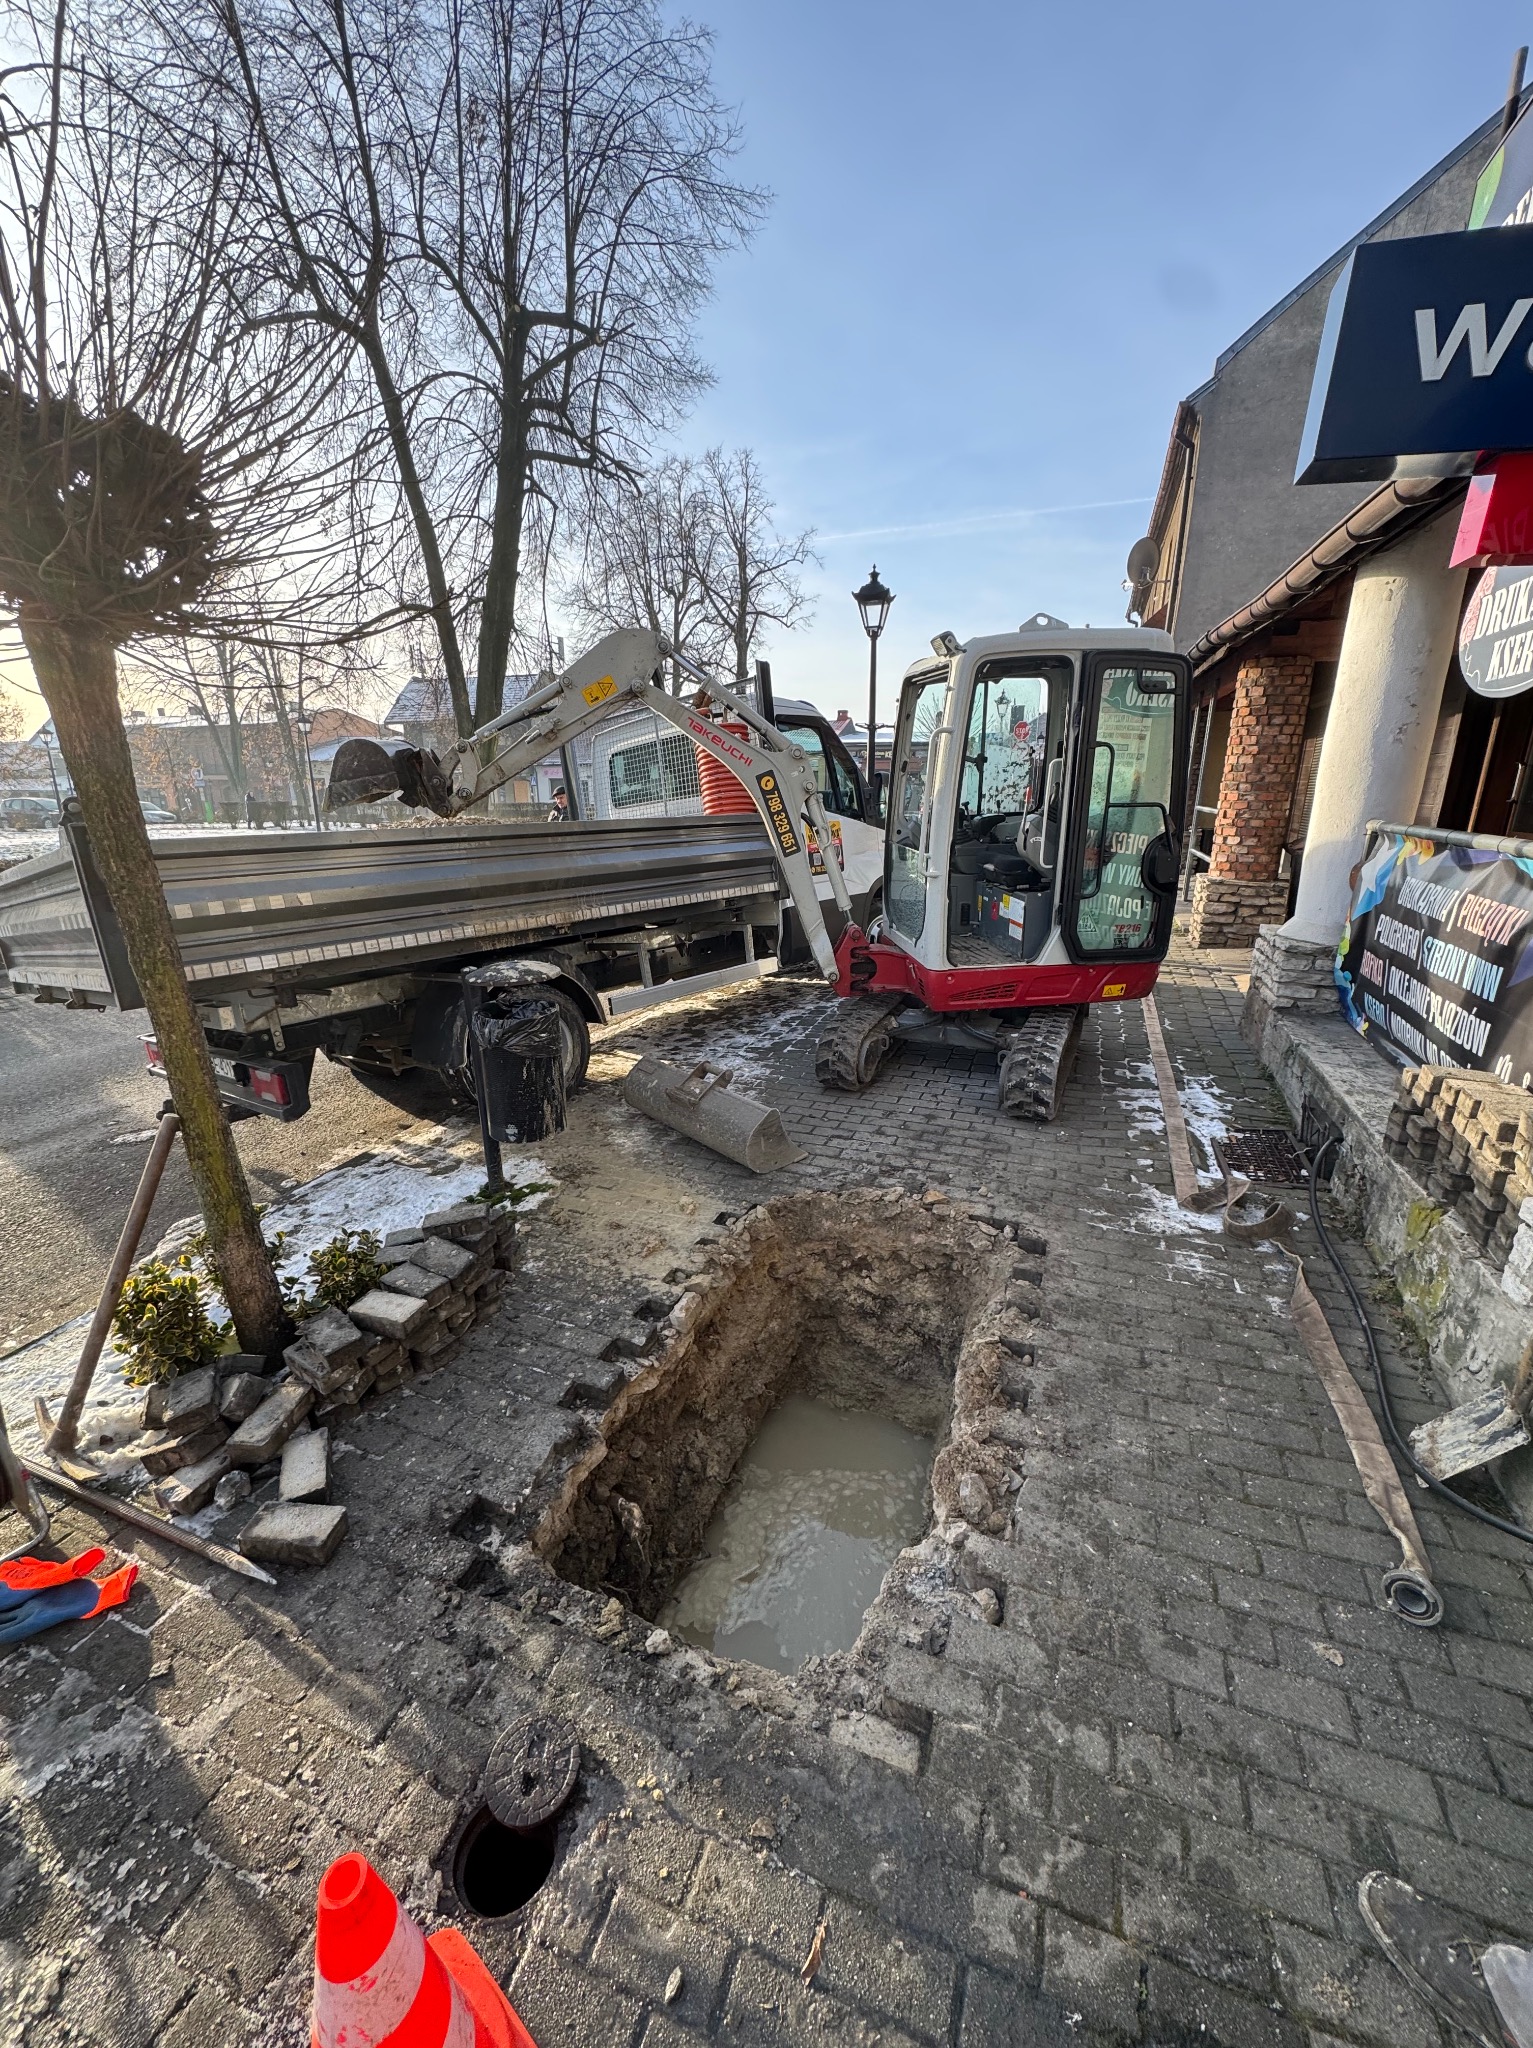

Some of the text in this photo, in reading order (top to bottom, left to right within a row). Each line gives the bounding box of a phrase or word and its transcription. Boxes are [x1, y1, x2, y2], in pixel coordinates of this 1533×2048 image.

[1414, 297, 1533, 383] W
[1473, 576, 1533, 640] DRUK
[766, 791, 797, 853] 798 329 651
[1114, 924, 1142, 933] TB216
[1398, 876, 1530, 947] DRUKARNIA PIECZĄTKI
[1374, 914, 1504, 1003] POLIGRAFIA STRONY WWW
[1360, 949, 1492, 1057] RAFIKA OKLEJANIE POJAZDÓW
[1364, 992, 1387, 1030] KSERO
[1391, 1011, 1428, 1063] NADRUKI
